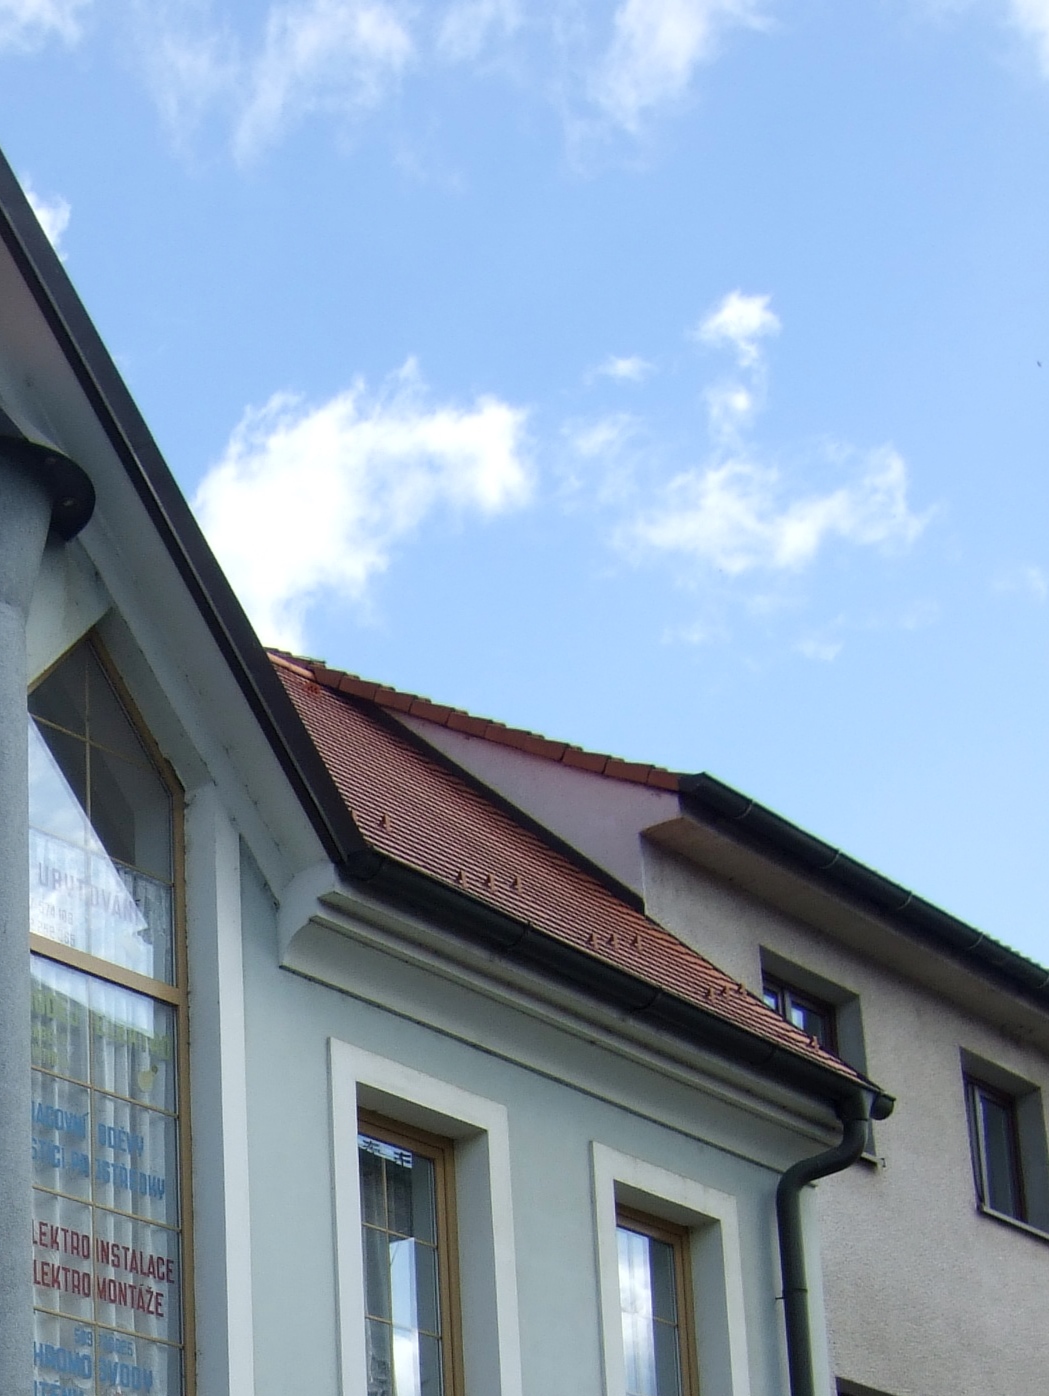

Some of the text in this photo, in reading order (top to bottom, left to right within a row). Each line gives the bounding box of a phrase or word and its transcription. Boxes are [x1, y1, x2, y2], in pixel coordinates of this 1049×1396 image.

[32, 1218, 176, 1285] LEKTRO INSTALACE
[33, 1258, 165, 1318] LEKTRO MONTÁŽE
